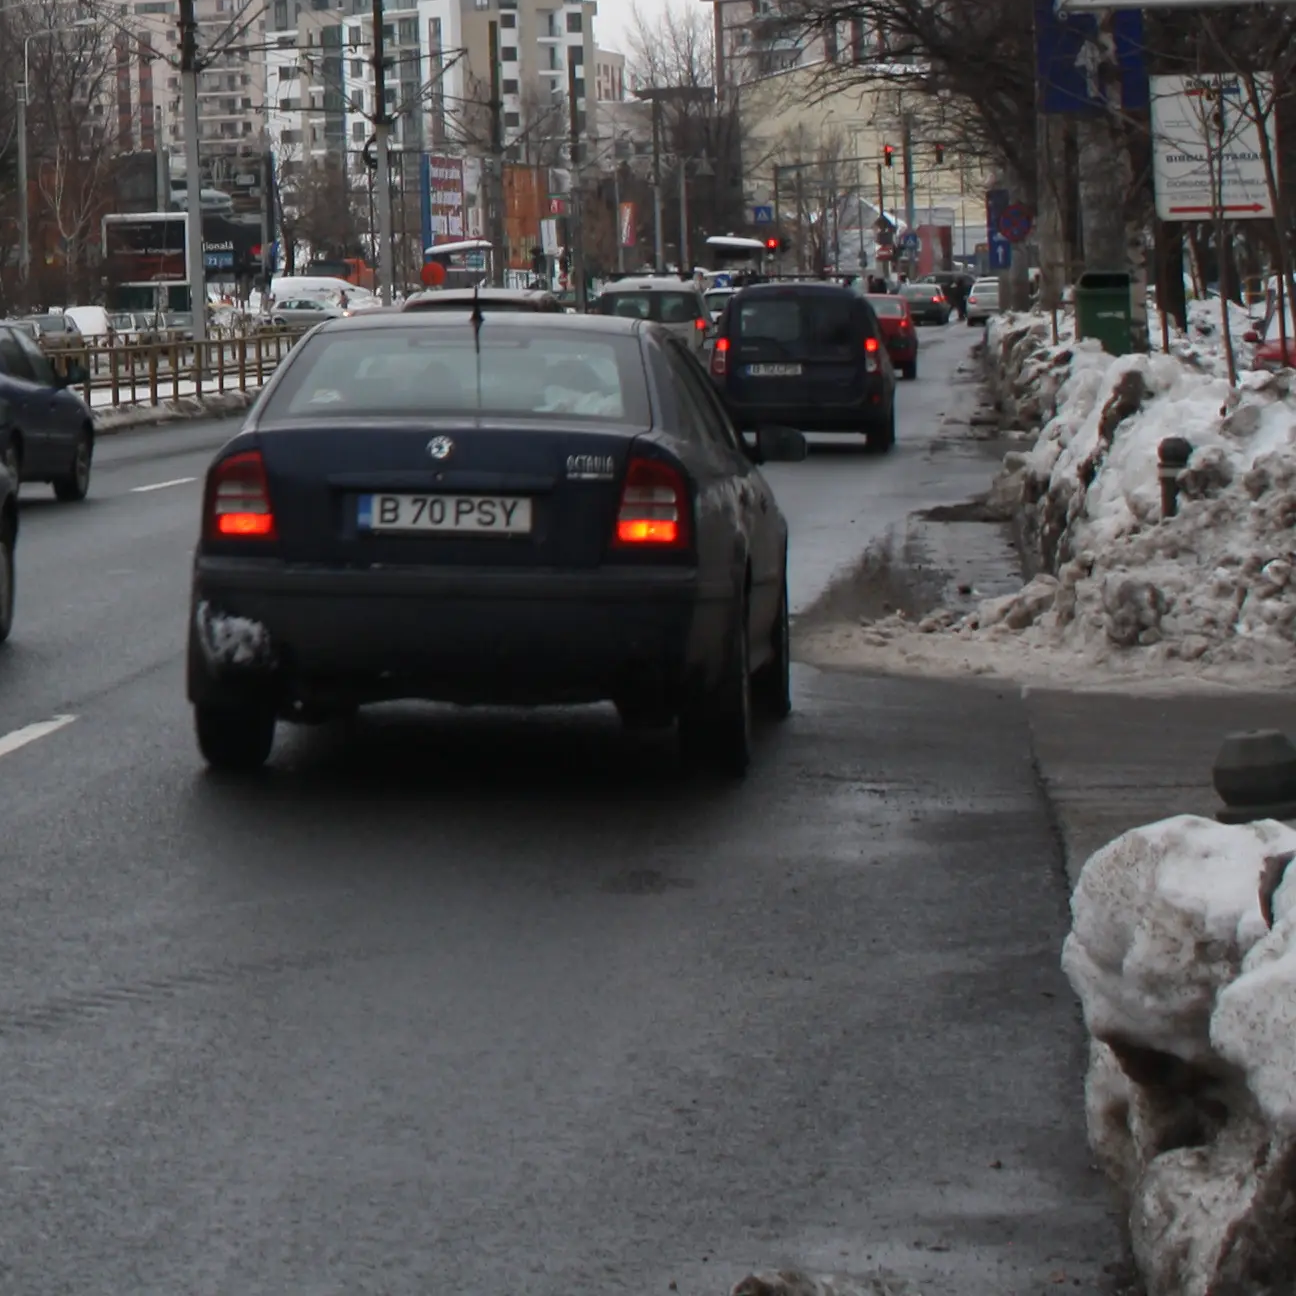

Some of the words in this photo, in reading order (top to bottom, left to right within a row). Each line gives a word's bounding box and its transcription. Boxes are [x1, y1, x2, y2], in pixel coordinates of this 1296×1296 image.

[378, 497, 400, 524] B
[411, 498, 446, 525] 70
[454, 499, 520, 528] PSY
